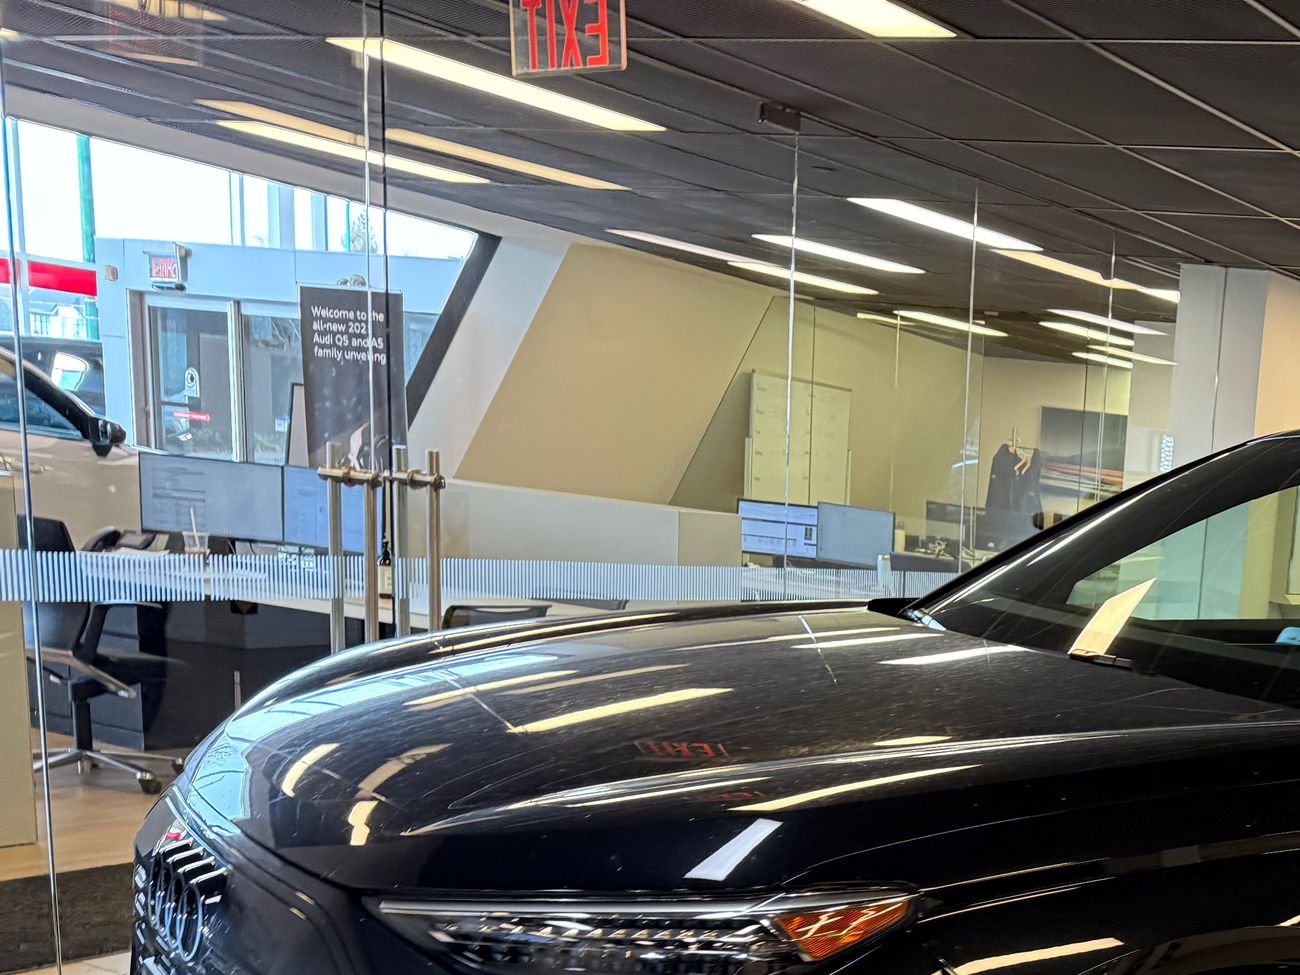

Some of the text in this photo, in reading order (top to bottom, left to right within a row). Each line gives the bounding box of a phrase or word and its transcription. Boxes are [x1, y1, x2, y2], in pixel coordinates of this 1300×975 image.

[311, 305, 384, 322] Welcome to he
[312, 319, 373, 335] all-new 202
[313, 331, 333, 346] Audi
[314, 346, 387, 366] family unveing
